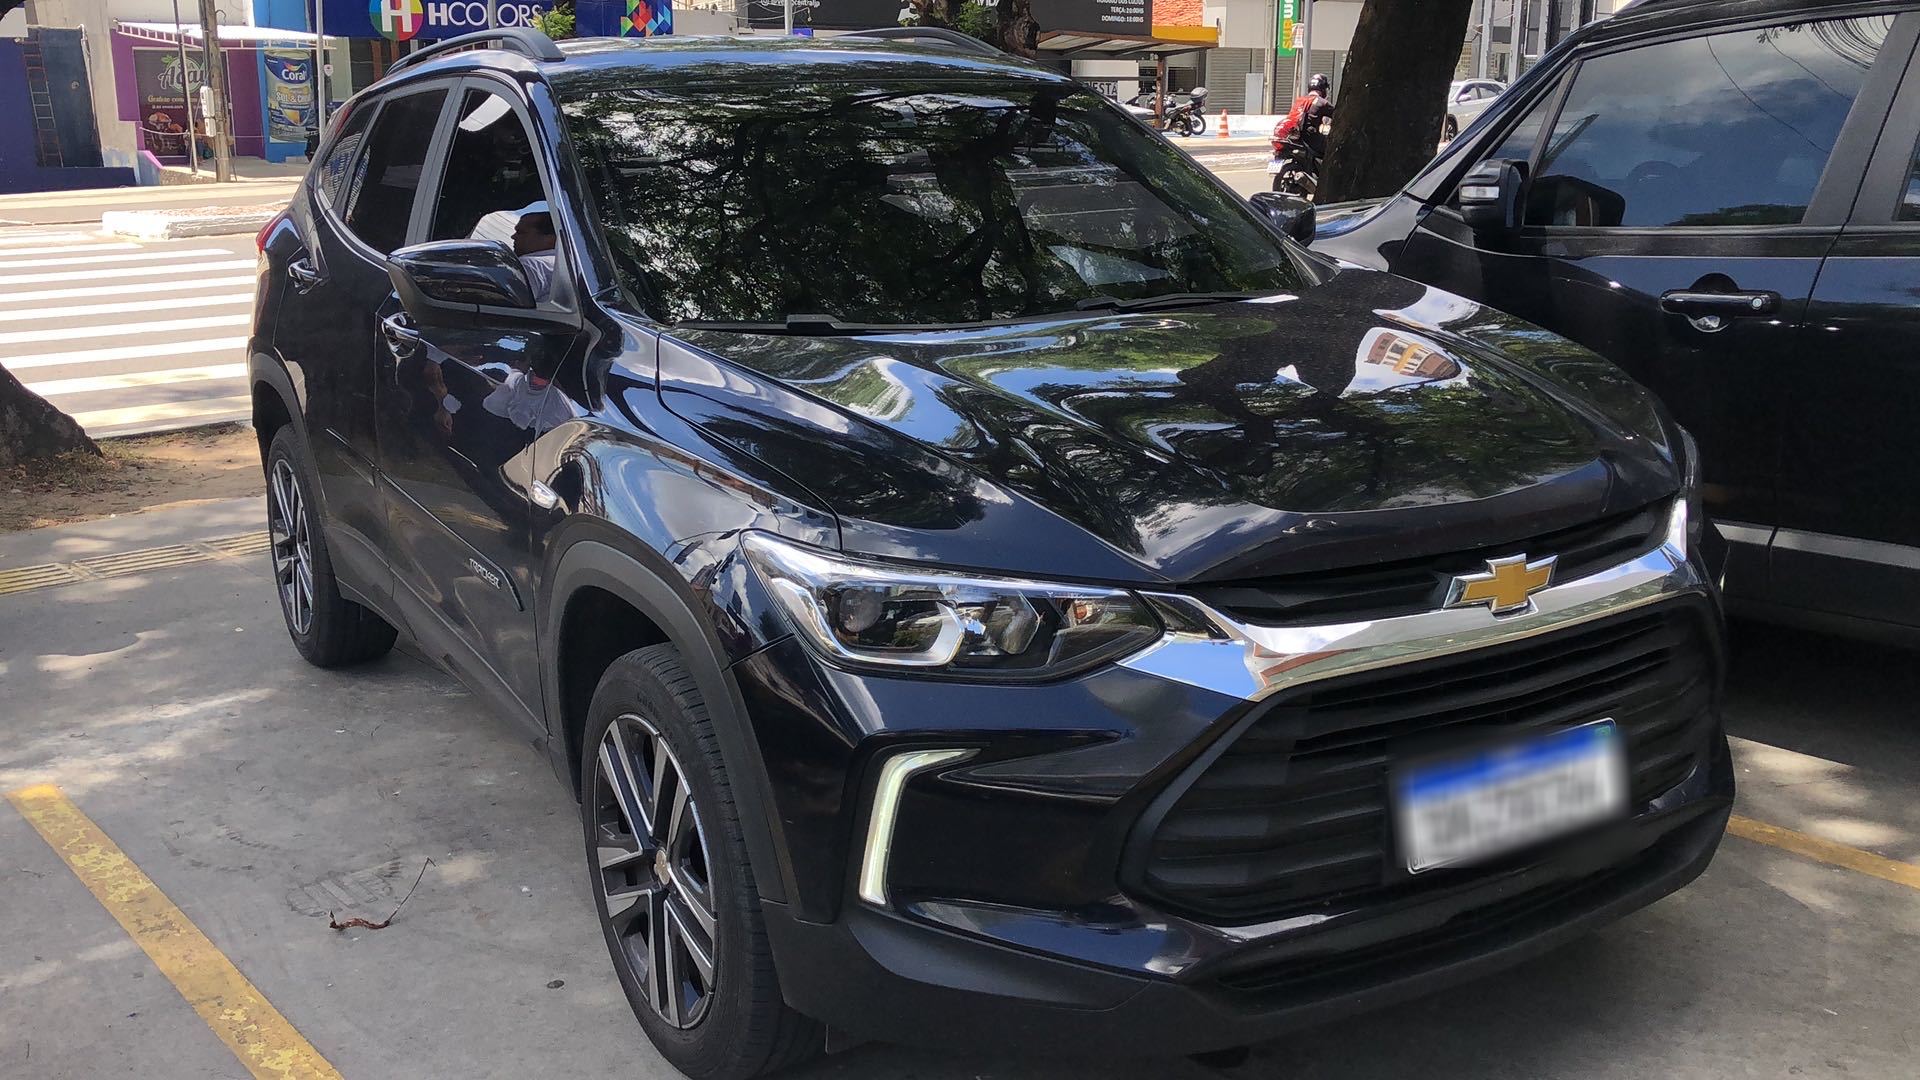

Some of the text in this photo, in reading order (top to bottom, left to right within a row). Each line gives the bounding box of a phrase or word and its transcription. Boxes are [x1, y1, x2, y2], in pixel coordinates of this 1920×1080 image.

[428, 2, 543, 27] HCOORS
[281, 69, 307, 81] Coral
[469, 558, 500, 589] TRACKER
